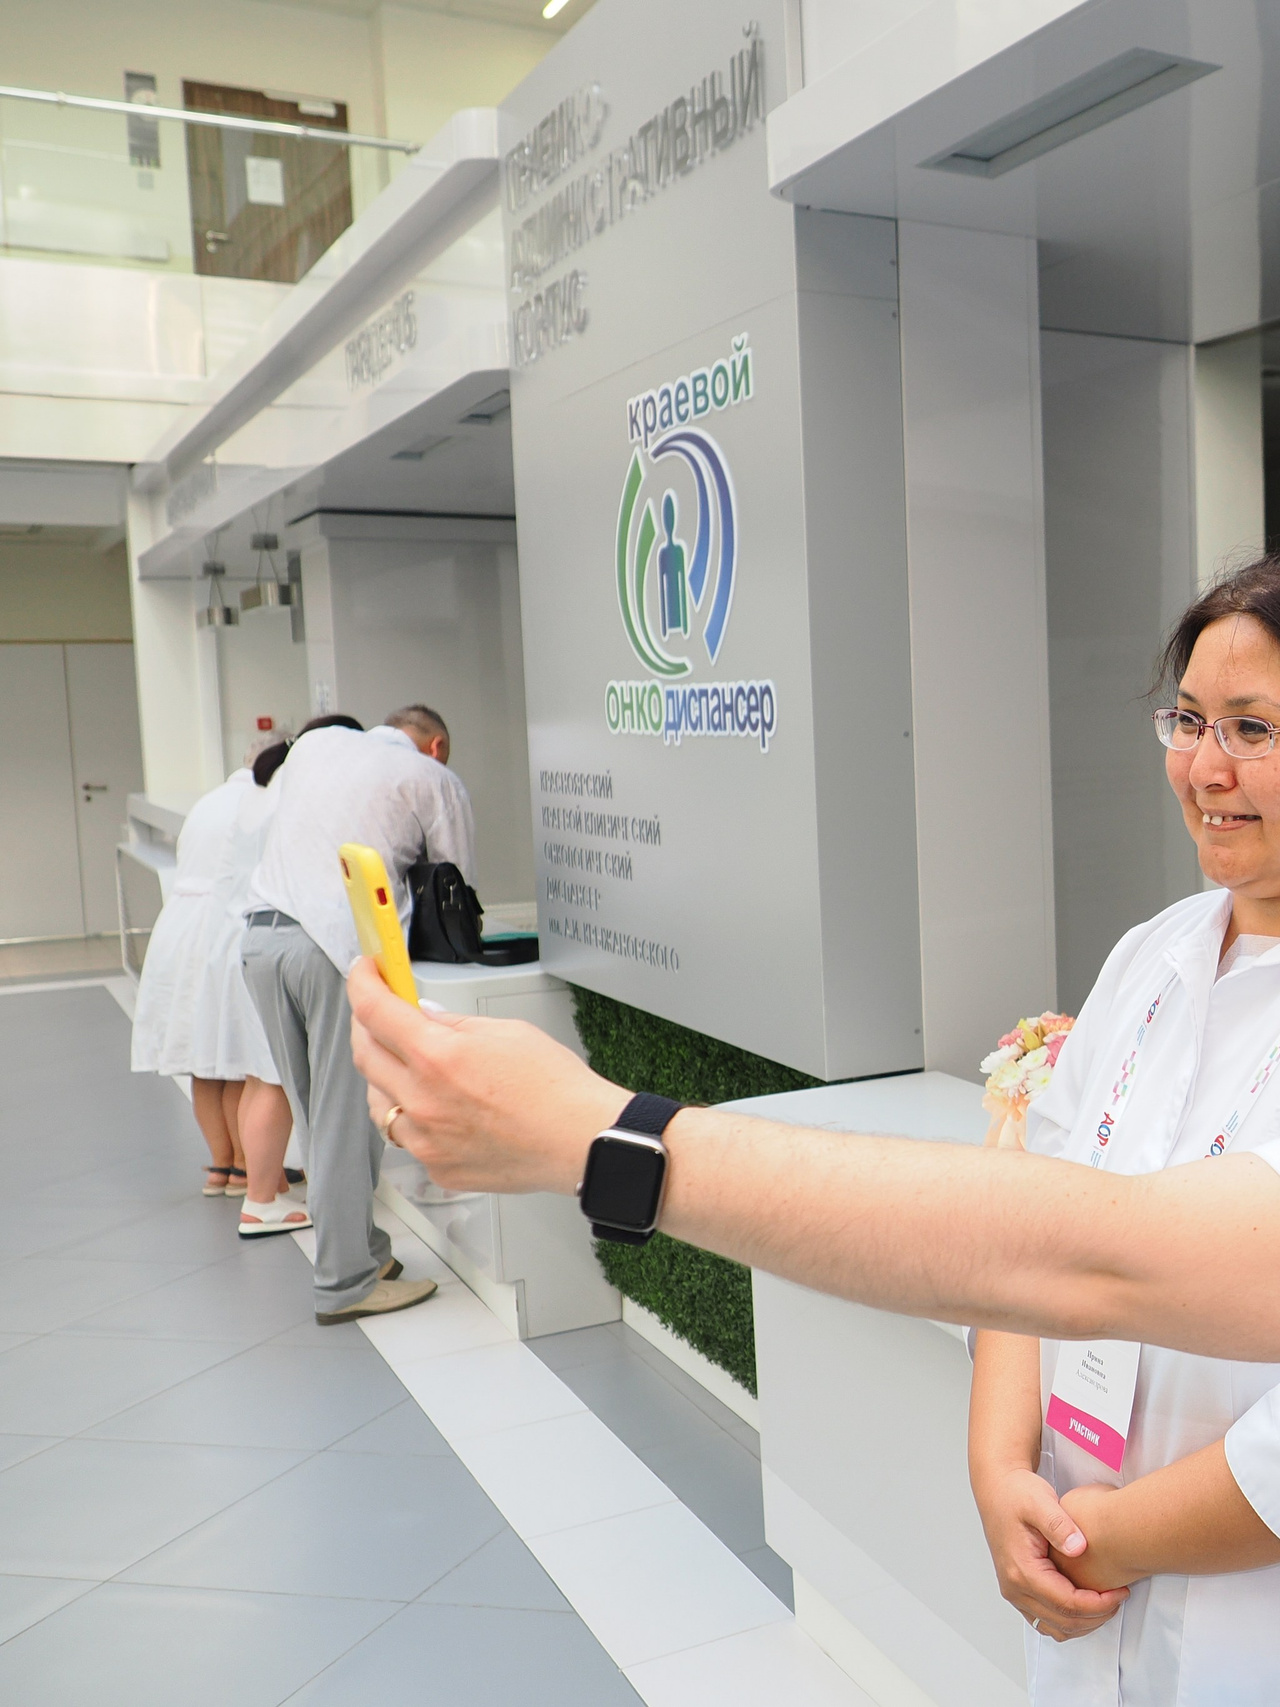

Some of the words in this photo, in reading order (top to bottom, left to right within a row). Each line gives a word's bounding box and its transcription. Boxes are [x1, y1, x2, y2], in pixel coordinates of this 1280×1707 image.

[511, 20, 766, 293] АДМИНИСТРАТИВНЫЙ
[513, 268, 590, 368] КОРПУС
[628, 335, 752, 451] краевой
[539, 768, 613, 799] КРАСНОЯРСКИЙ
[541, 804, 582, 834] КРАЕВОЙ
[584, 811, 661, 847] КЛИНИЧЕСКИЙ
[543, 841, 633, 881] ОНКОЛОГИЧЕСКИЙ
[546, 876, 601, 911] ДИСПАНСЕР
[583, 921, 679, 974] КРЫЖАНОВСКОГО
[1204, 1134, 1225, 1159] ОР
[1068, 1417, 1101, 1446] УЧАСТНИК
